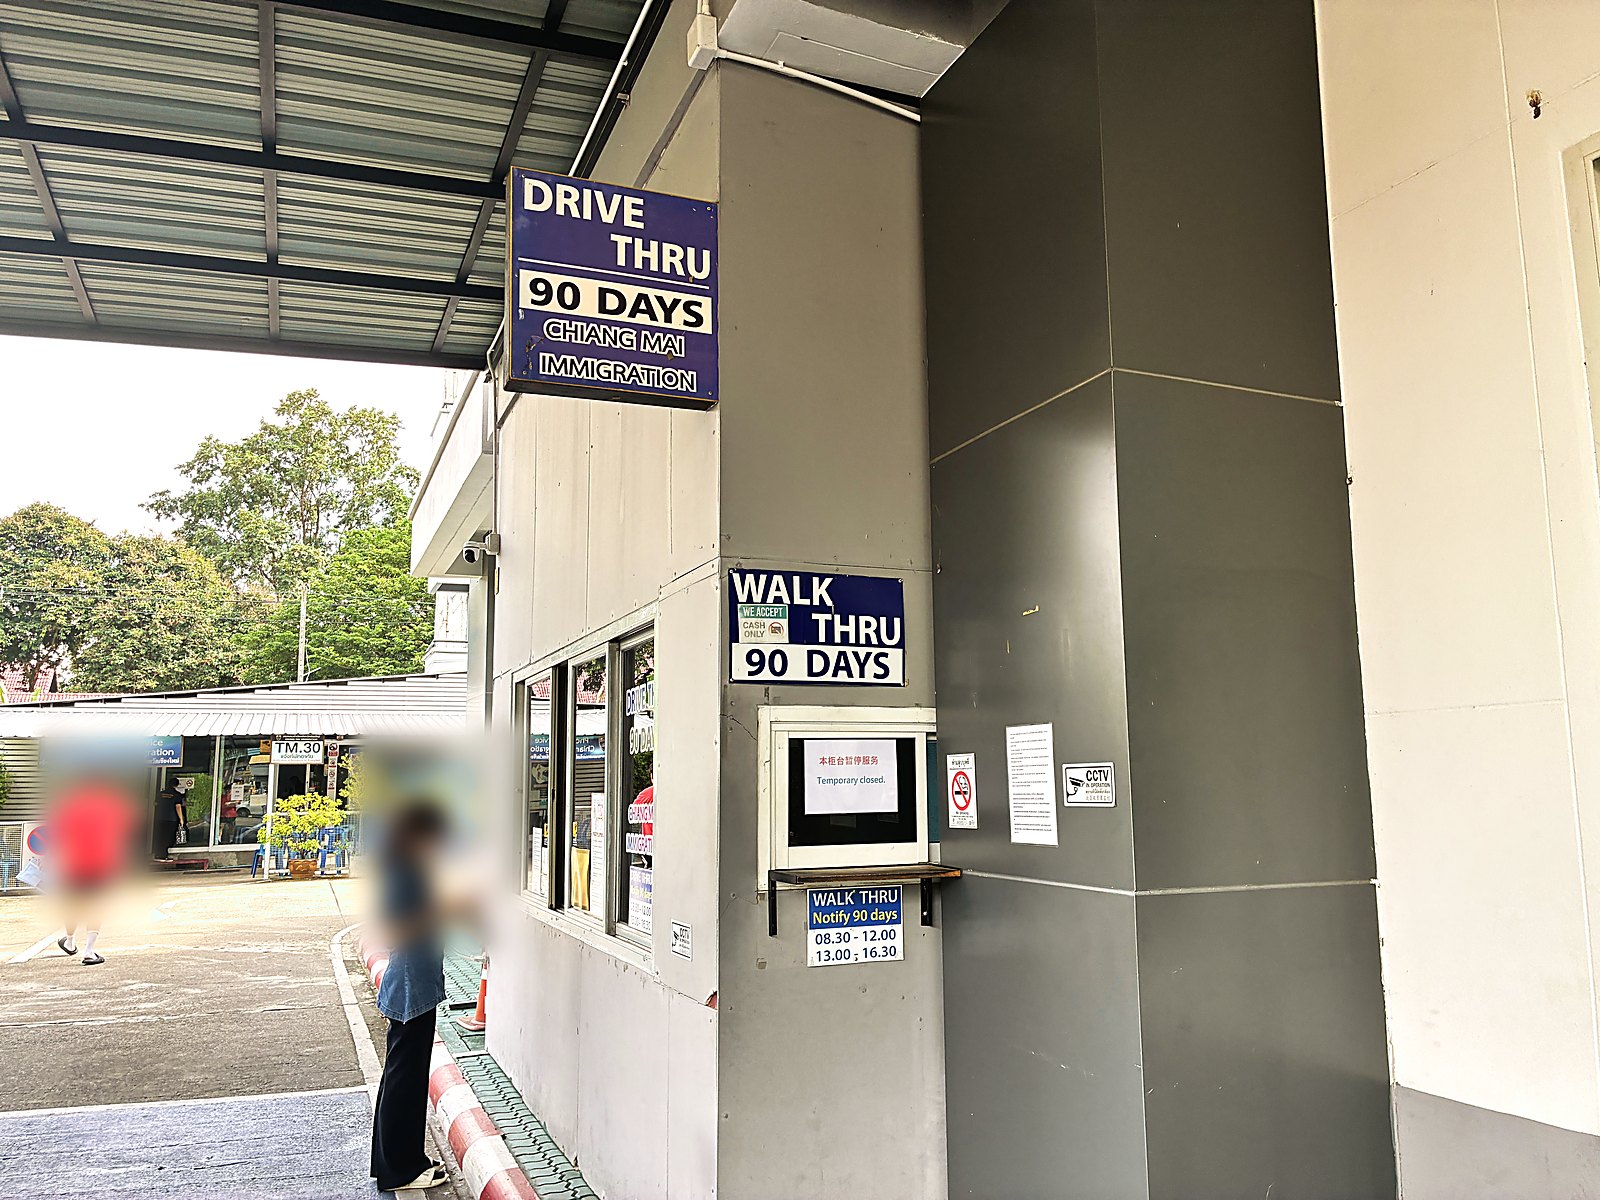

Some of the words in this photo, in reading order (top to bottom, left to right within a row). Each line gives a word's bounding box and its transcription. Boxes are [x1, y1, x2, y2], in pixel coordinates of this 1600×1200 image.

[524, 178, 644, 229] DRIVE
[610, 234, 711, 279] THRU
[529, 278, 580, 310] 90
[598, 287, 704, 327] DAYS
[543, 318, 636, 350] CHIANG
[641, 333, 684, 357] MAI
[539, 352, 696, 392] IMMIGRATION
[732, 573, 834, 607] WALK
[743, 606, 755, 617] WE
[756, 606, 783, 617] ACCEPT
[743, 621, 766, 629] CASH
[744, 630, 765, 638] ONLY
[812, 613, 900, 646] THRU
[745, 649, 788, 677] 90
[806, 649, 890, 680] DAYS
[627, 685, 646, 714] DRIVE
[275, 742, 321, 754] TM.30
[630, 728, 639, 754] 90
[819, 755, 879, 766] 本柜台暂停服务
[817, 776, 859, 786] Temporary
[859, 775, 886, 784] closed.
[1086, 769, 1109, 781] CCTV
[813, 890, 855, 907] WALK
[859, 889, 898, 904] THRU
[813, 909, 850, 926] Notify
[852, 909, 868, 922] 90
[870, 908, 898, 923] days
[815, 931, 851, 945] 08.30
[862, 928, 896, 942] 12.00
[816, 948, 851, 962] 13.00
[862, 945, 897, 959] 16.30
